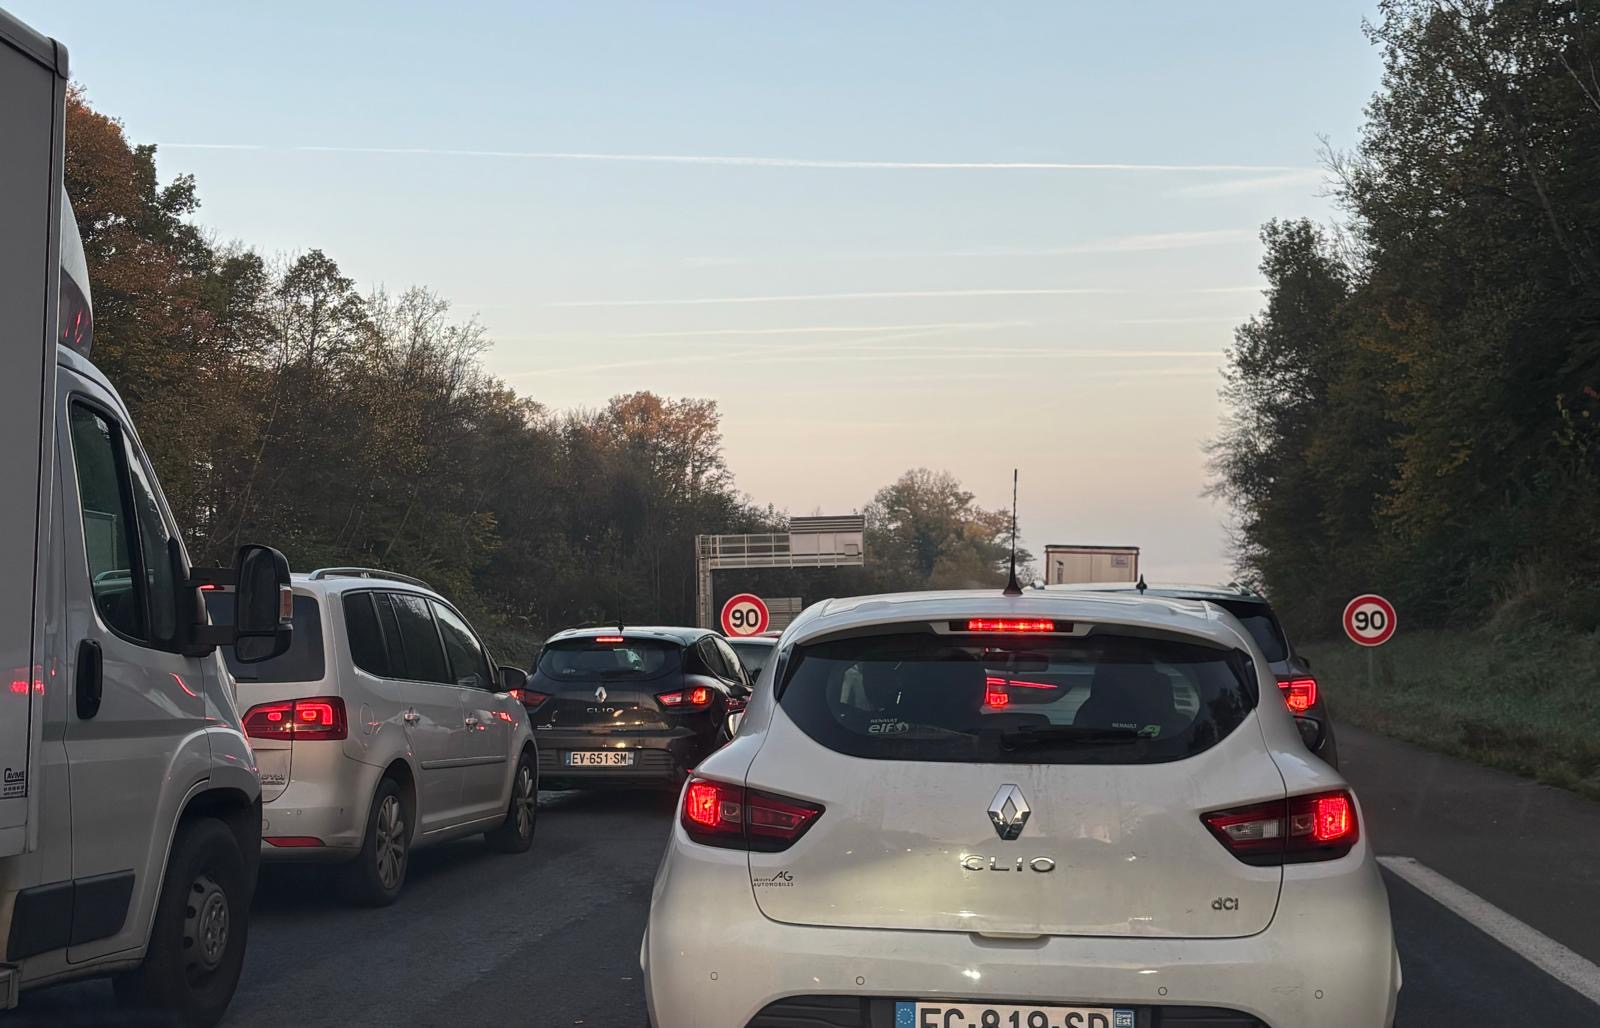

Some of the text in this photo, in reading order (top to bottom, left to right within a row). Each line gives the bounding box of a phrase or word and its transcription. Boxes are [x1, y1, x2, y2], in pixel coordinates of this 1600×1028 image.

[731, 608, 759, 628] 90
[1354, 610, 1385, 631] 90
[868, 723, 894, 733] elf
[572, 753, 627, 764] EV-651-SM
[960, 855, 1056, 873] CLIO
[771, 871, 793, 882] AG
